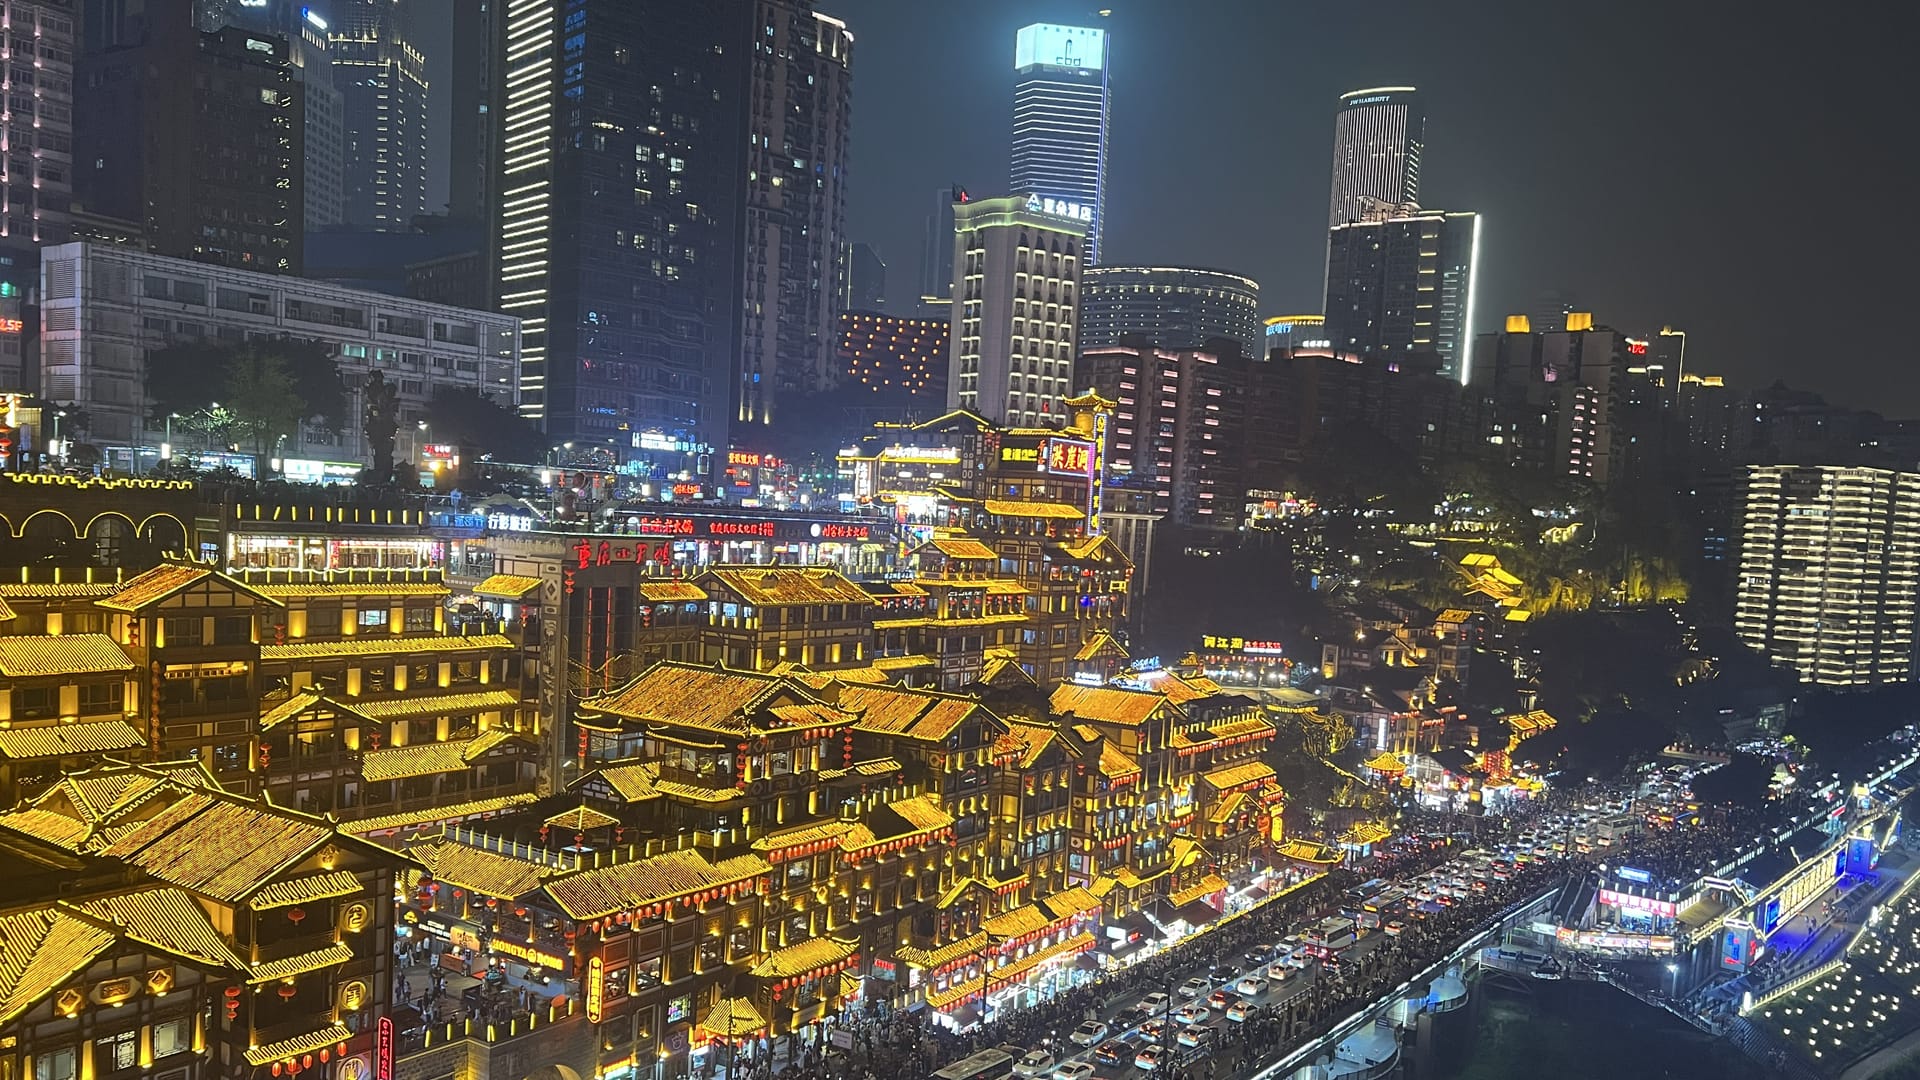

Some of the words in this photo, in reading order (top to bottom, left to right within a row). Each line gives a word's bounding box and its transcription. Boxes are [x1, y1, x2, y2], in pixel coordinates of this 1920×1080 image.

[1052, 444, 1089, 471] 洪崖洞
[492, 938, 527, 960] HONGYA
[537, 952, 564, 971] DONG
